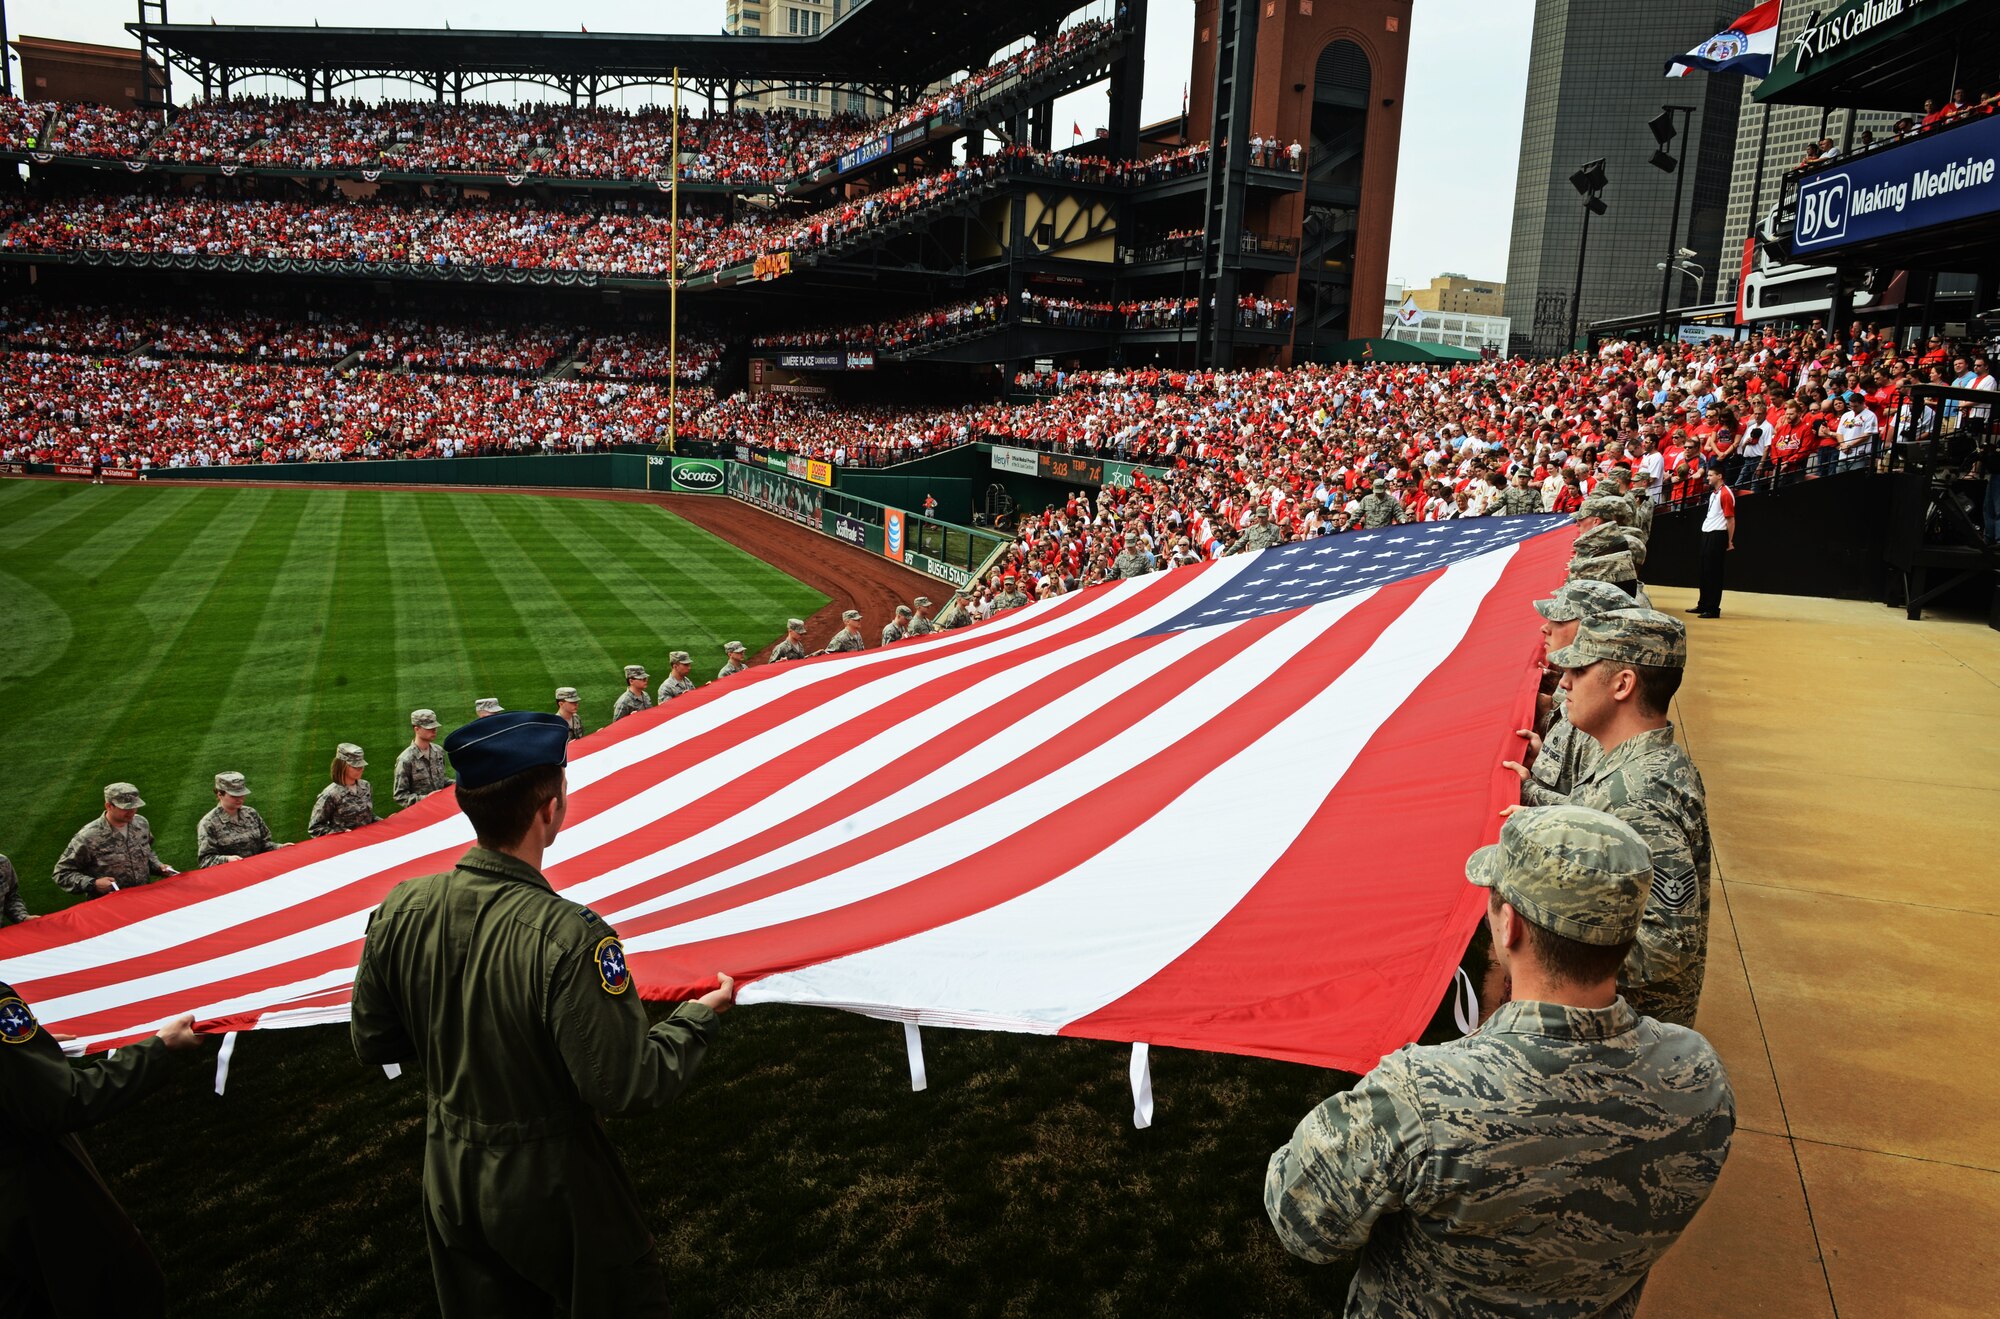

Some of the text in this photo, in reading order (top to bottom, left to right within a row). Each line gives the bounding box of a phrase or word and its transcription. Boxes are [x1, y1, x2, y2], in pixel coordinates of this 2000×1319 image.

[1818, 0, 1904, 53] U.S. Cellular
[1851, 156, 1996, 217] Making Medicine
[1801, 185, 1844, 239] BJC
[800, 355, 815, 366] PLACE
[678, 468, 718, 482] Scotts
[927, 559, 948, 581] BUSCH
